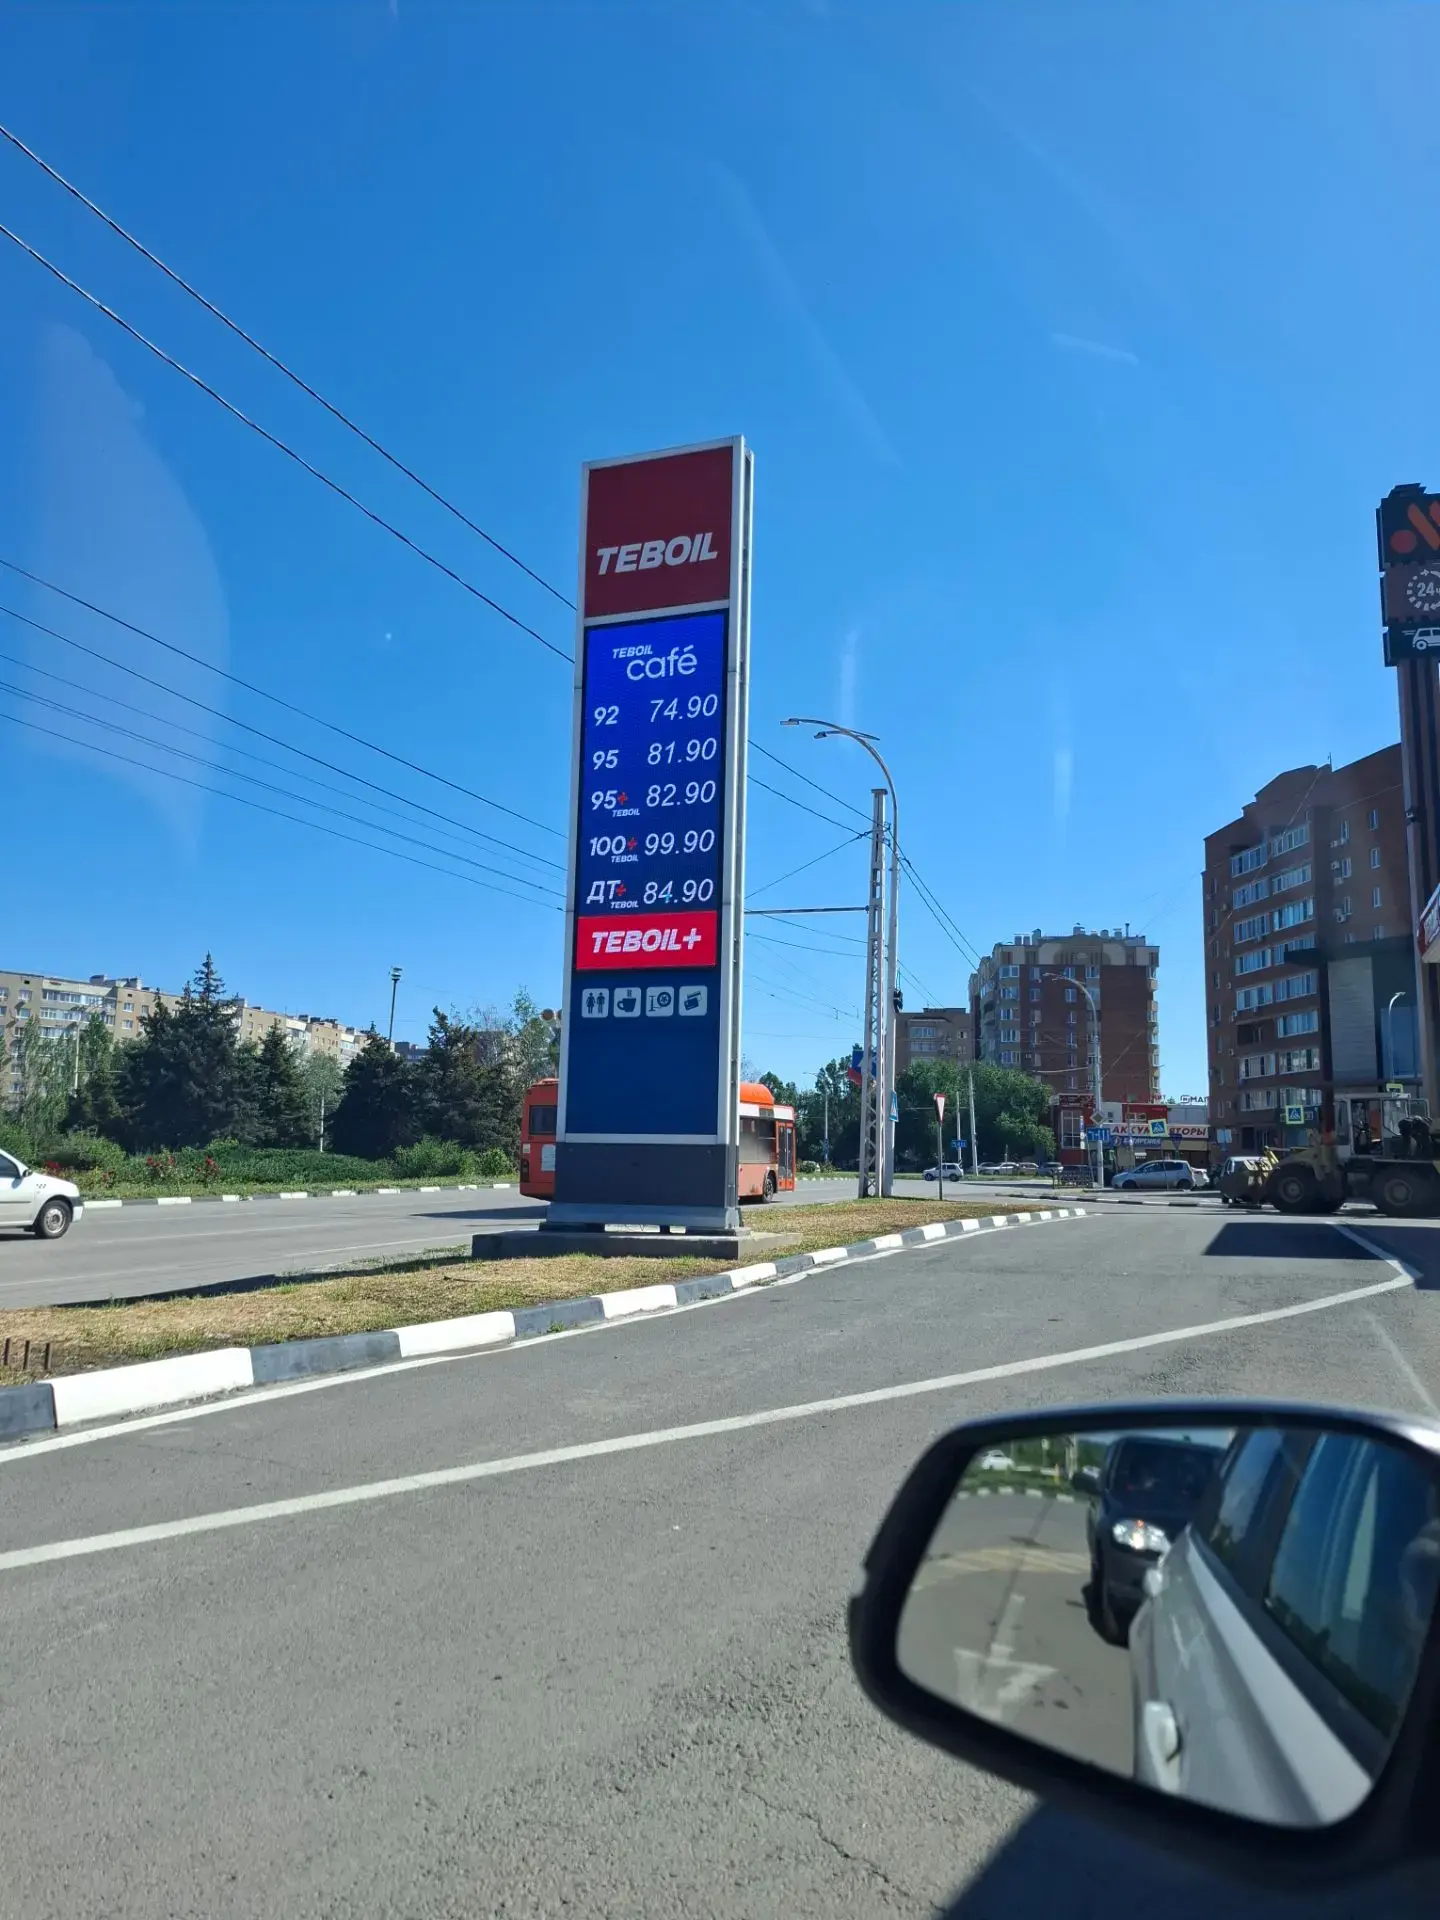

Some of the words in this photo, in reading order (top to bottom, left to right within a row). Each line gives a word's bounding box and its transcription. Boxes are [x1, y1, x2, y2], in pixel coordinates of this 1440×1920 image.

[597, 532, 718, 575] TEBOIL
[612, 645, 653, 659] TEBOIL
[626, 645, 698, 681] café
[594, 705, 620, 727] 92
[650, 694, 718, 723] 74.90
[592, 750, 620, 770] 95
[647, 737, 717, 765] 81.90
[646, 780, 716, 807] 82.90
[612, 808, 641, 817] TEBOIL
[644, 829, 715, 856] 99.90
[611, 854, 639, 863] TEBOIL
[610, 900, 639, 909] TEBOIL
[643, 879, 714, 905] 84.90
[592, 928, 702, 954] TEBOIL+
